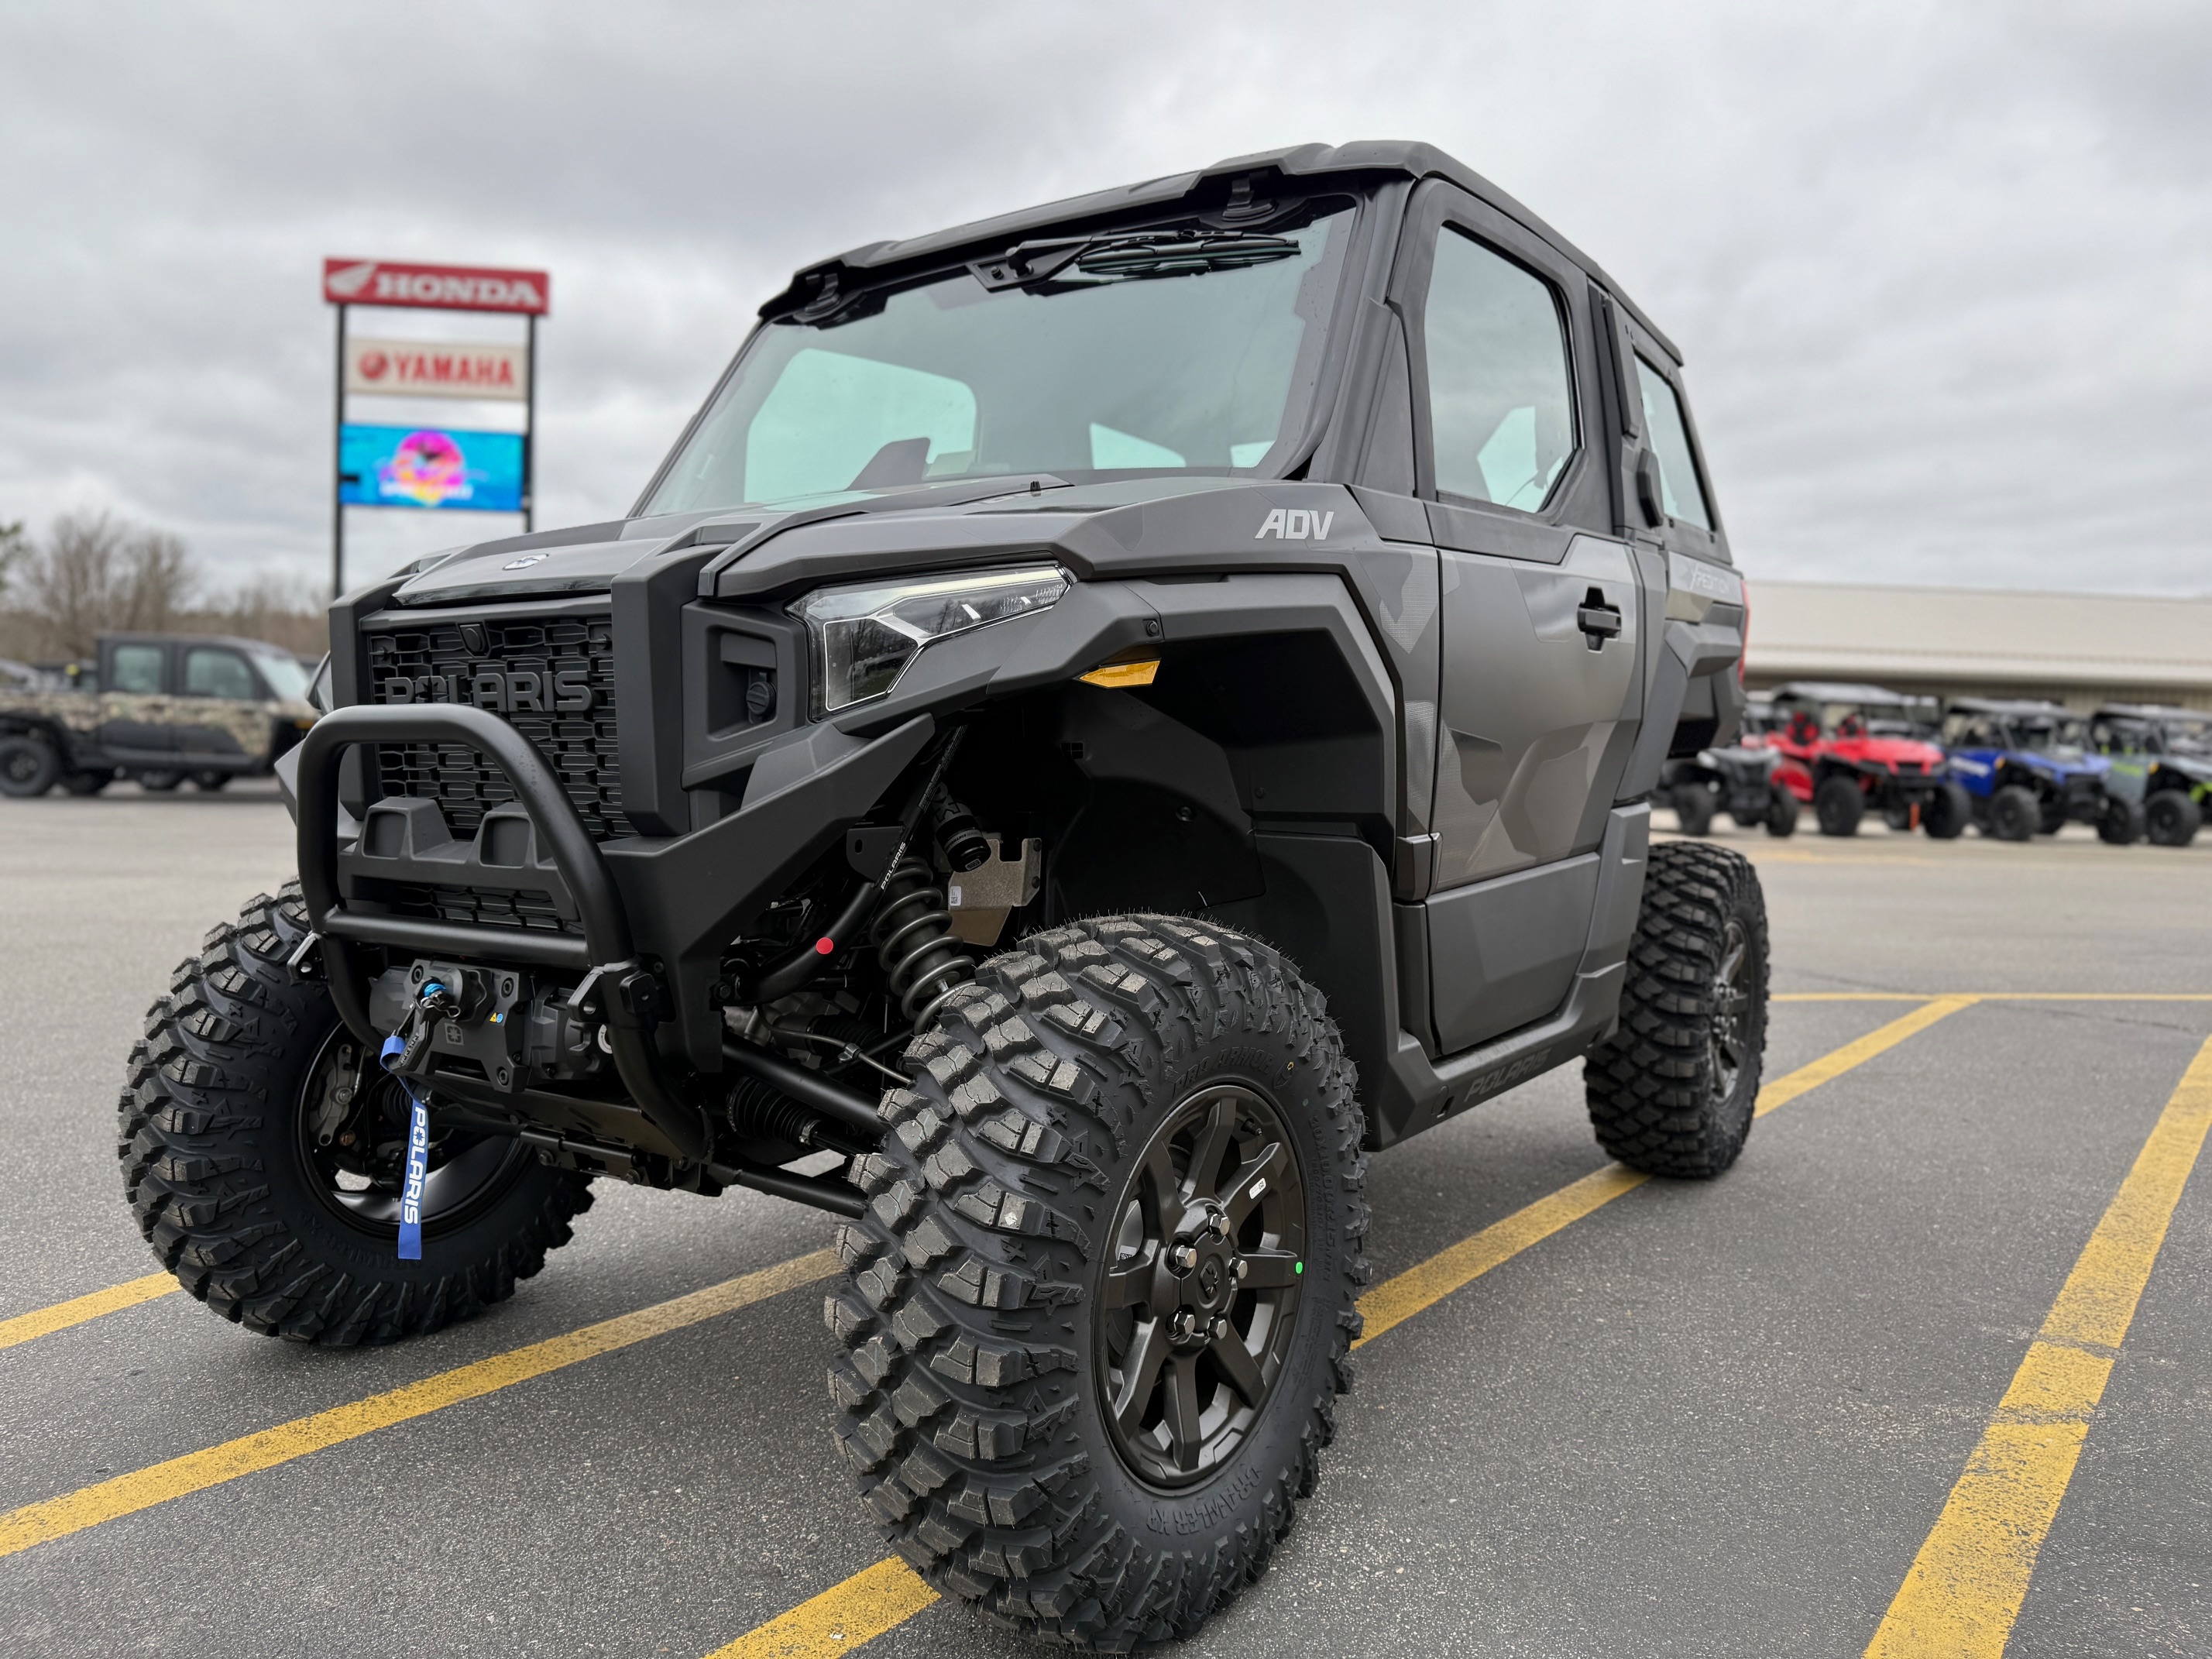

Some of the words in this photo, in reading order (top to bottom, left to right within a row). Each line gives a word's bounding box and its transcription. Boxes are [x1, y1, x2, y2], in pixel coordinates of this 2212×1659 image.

[375, 272, 541, 307] HONDA
[394, 352, 514, 386] YAMAHA
[1254, 508, 1334, 541] ADV
[385, 670, 592, 713] POLARIS
[880, 841, 906, 891] POLARIS
[1464, 1046, 1553, 1103] POLARIS
[404, 1106, 426, 1225] POLARIS
